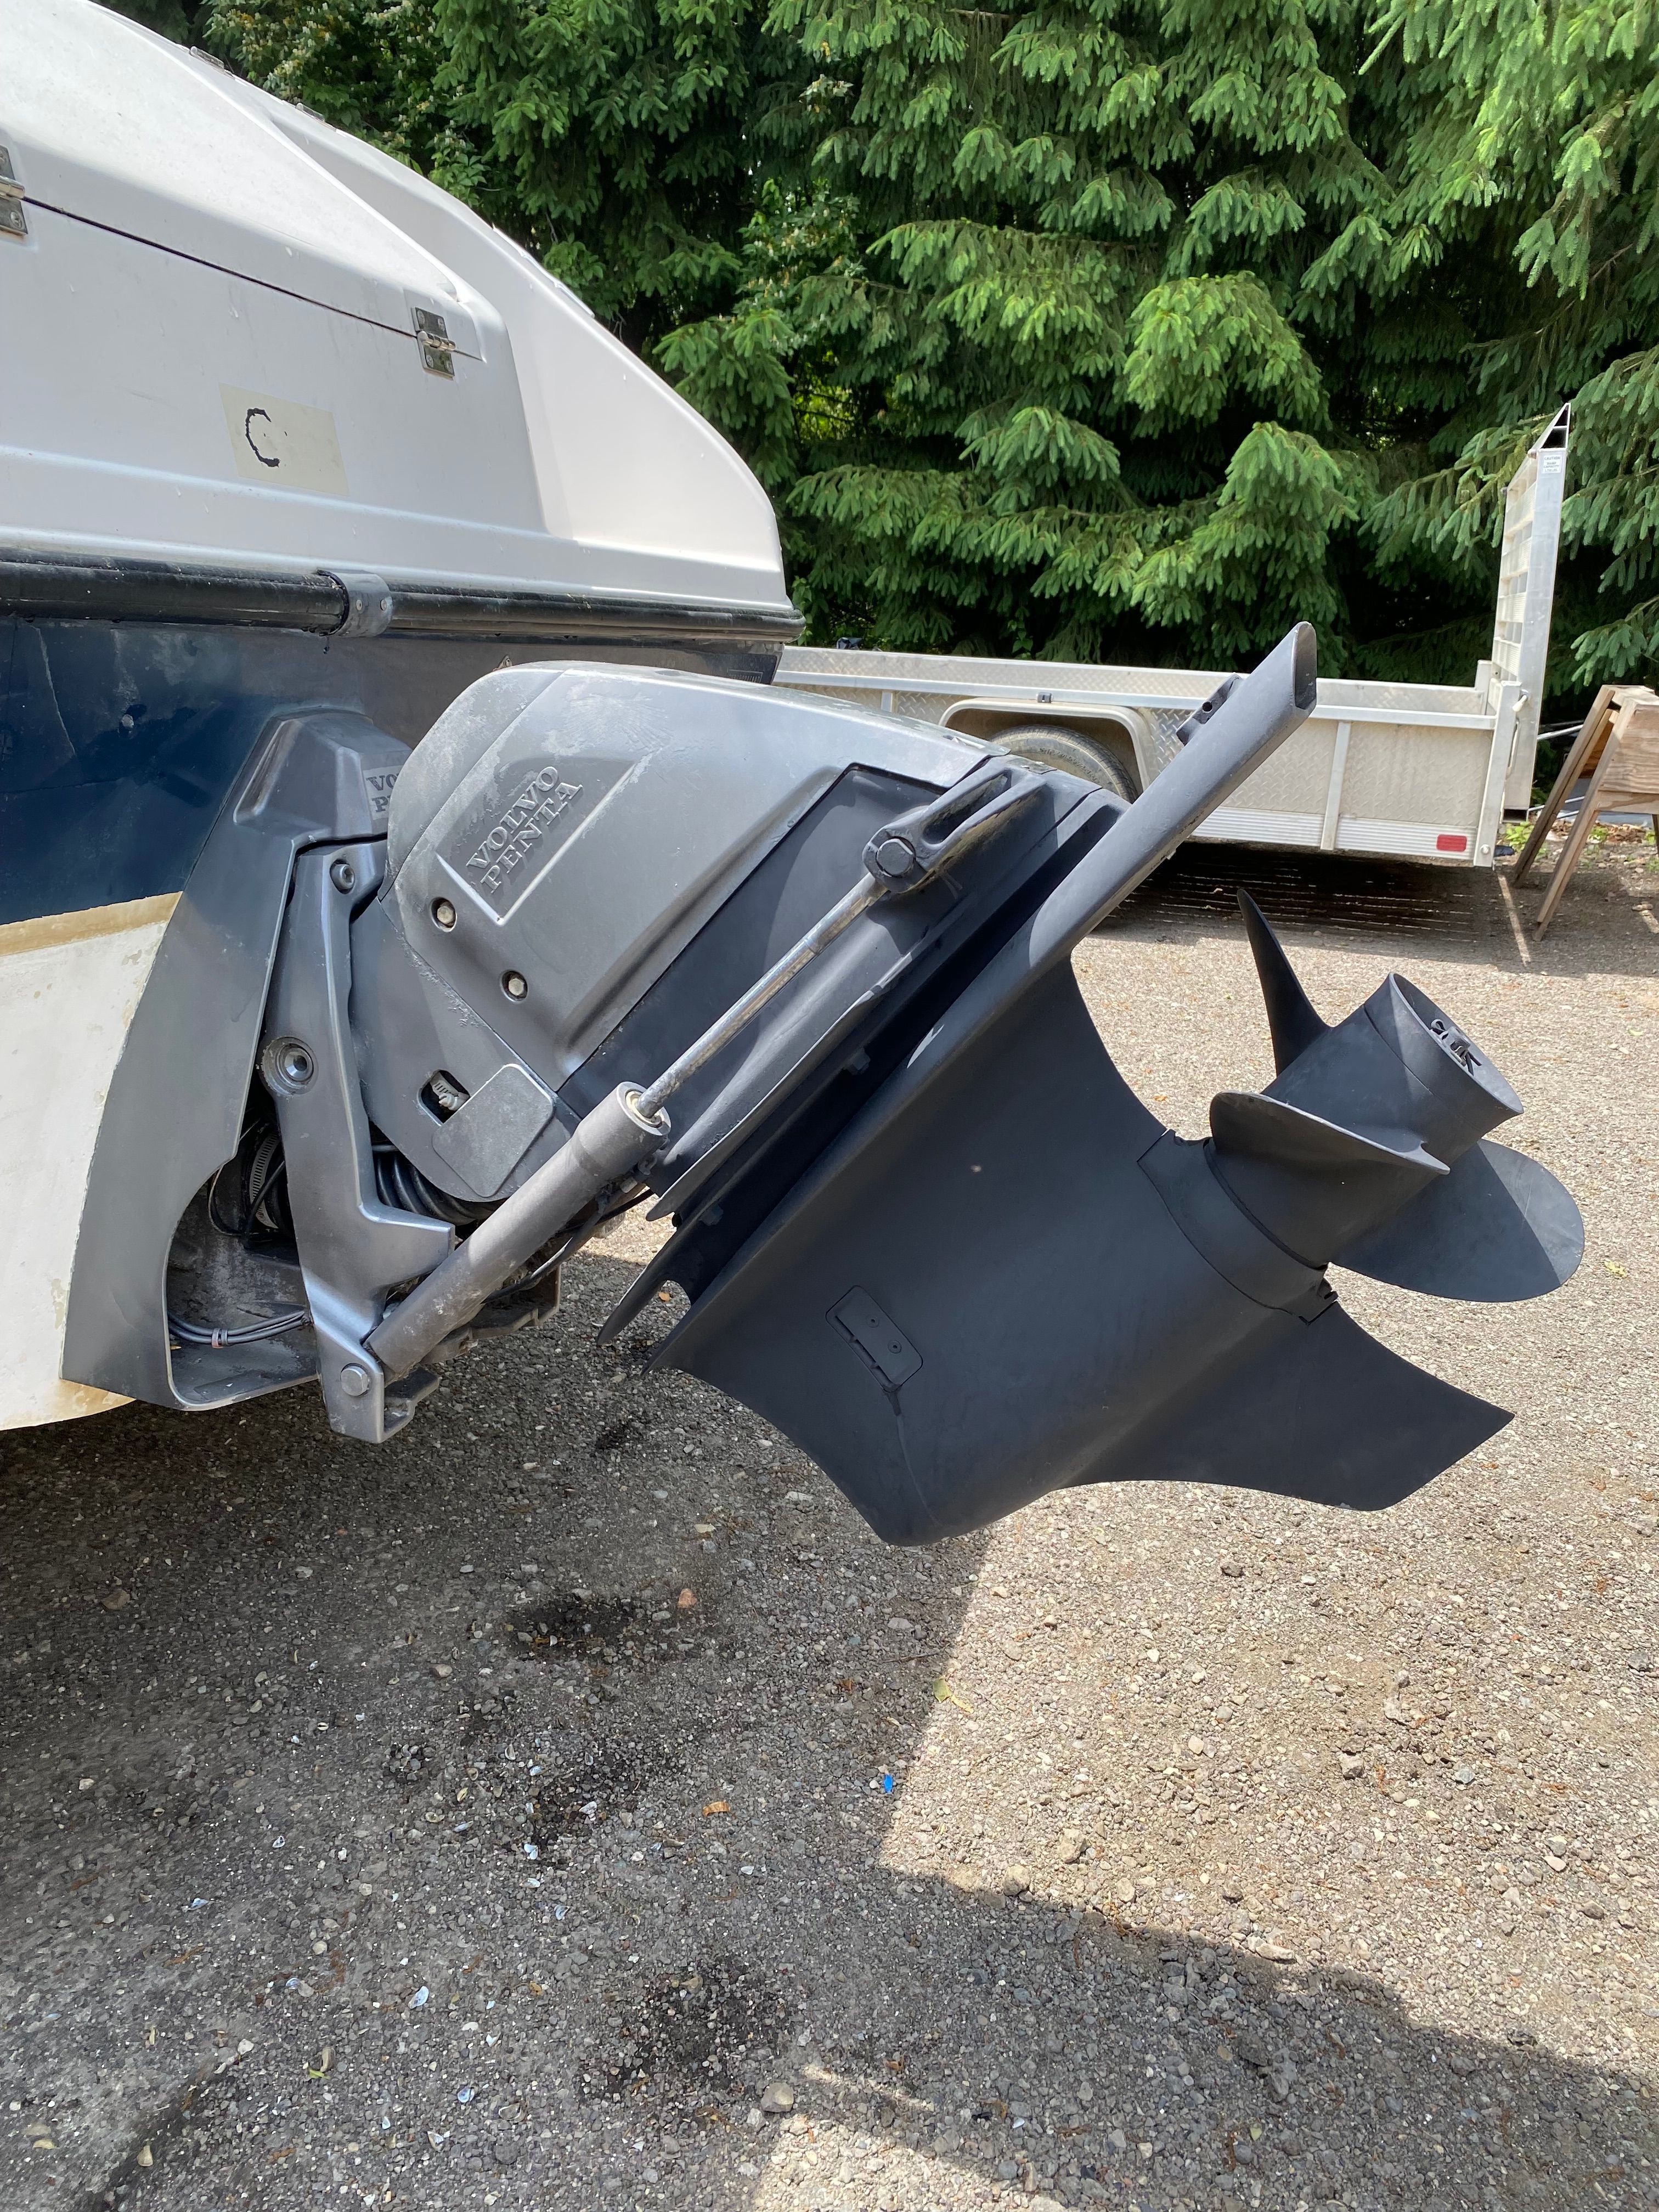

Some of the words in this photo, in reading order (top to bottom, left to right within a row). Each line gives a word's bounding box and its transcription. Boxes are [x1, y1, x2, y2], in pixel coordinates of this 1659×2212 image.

[245, 408, 280, 467] C
[366, 772, 399, 791] VO
[466, 766, 558, 869] VOLVO
[480, 782, 583, 894] PENTA
